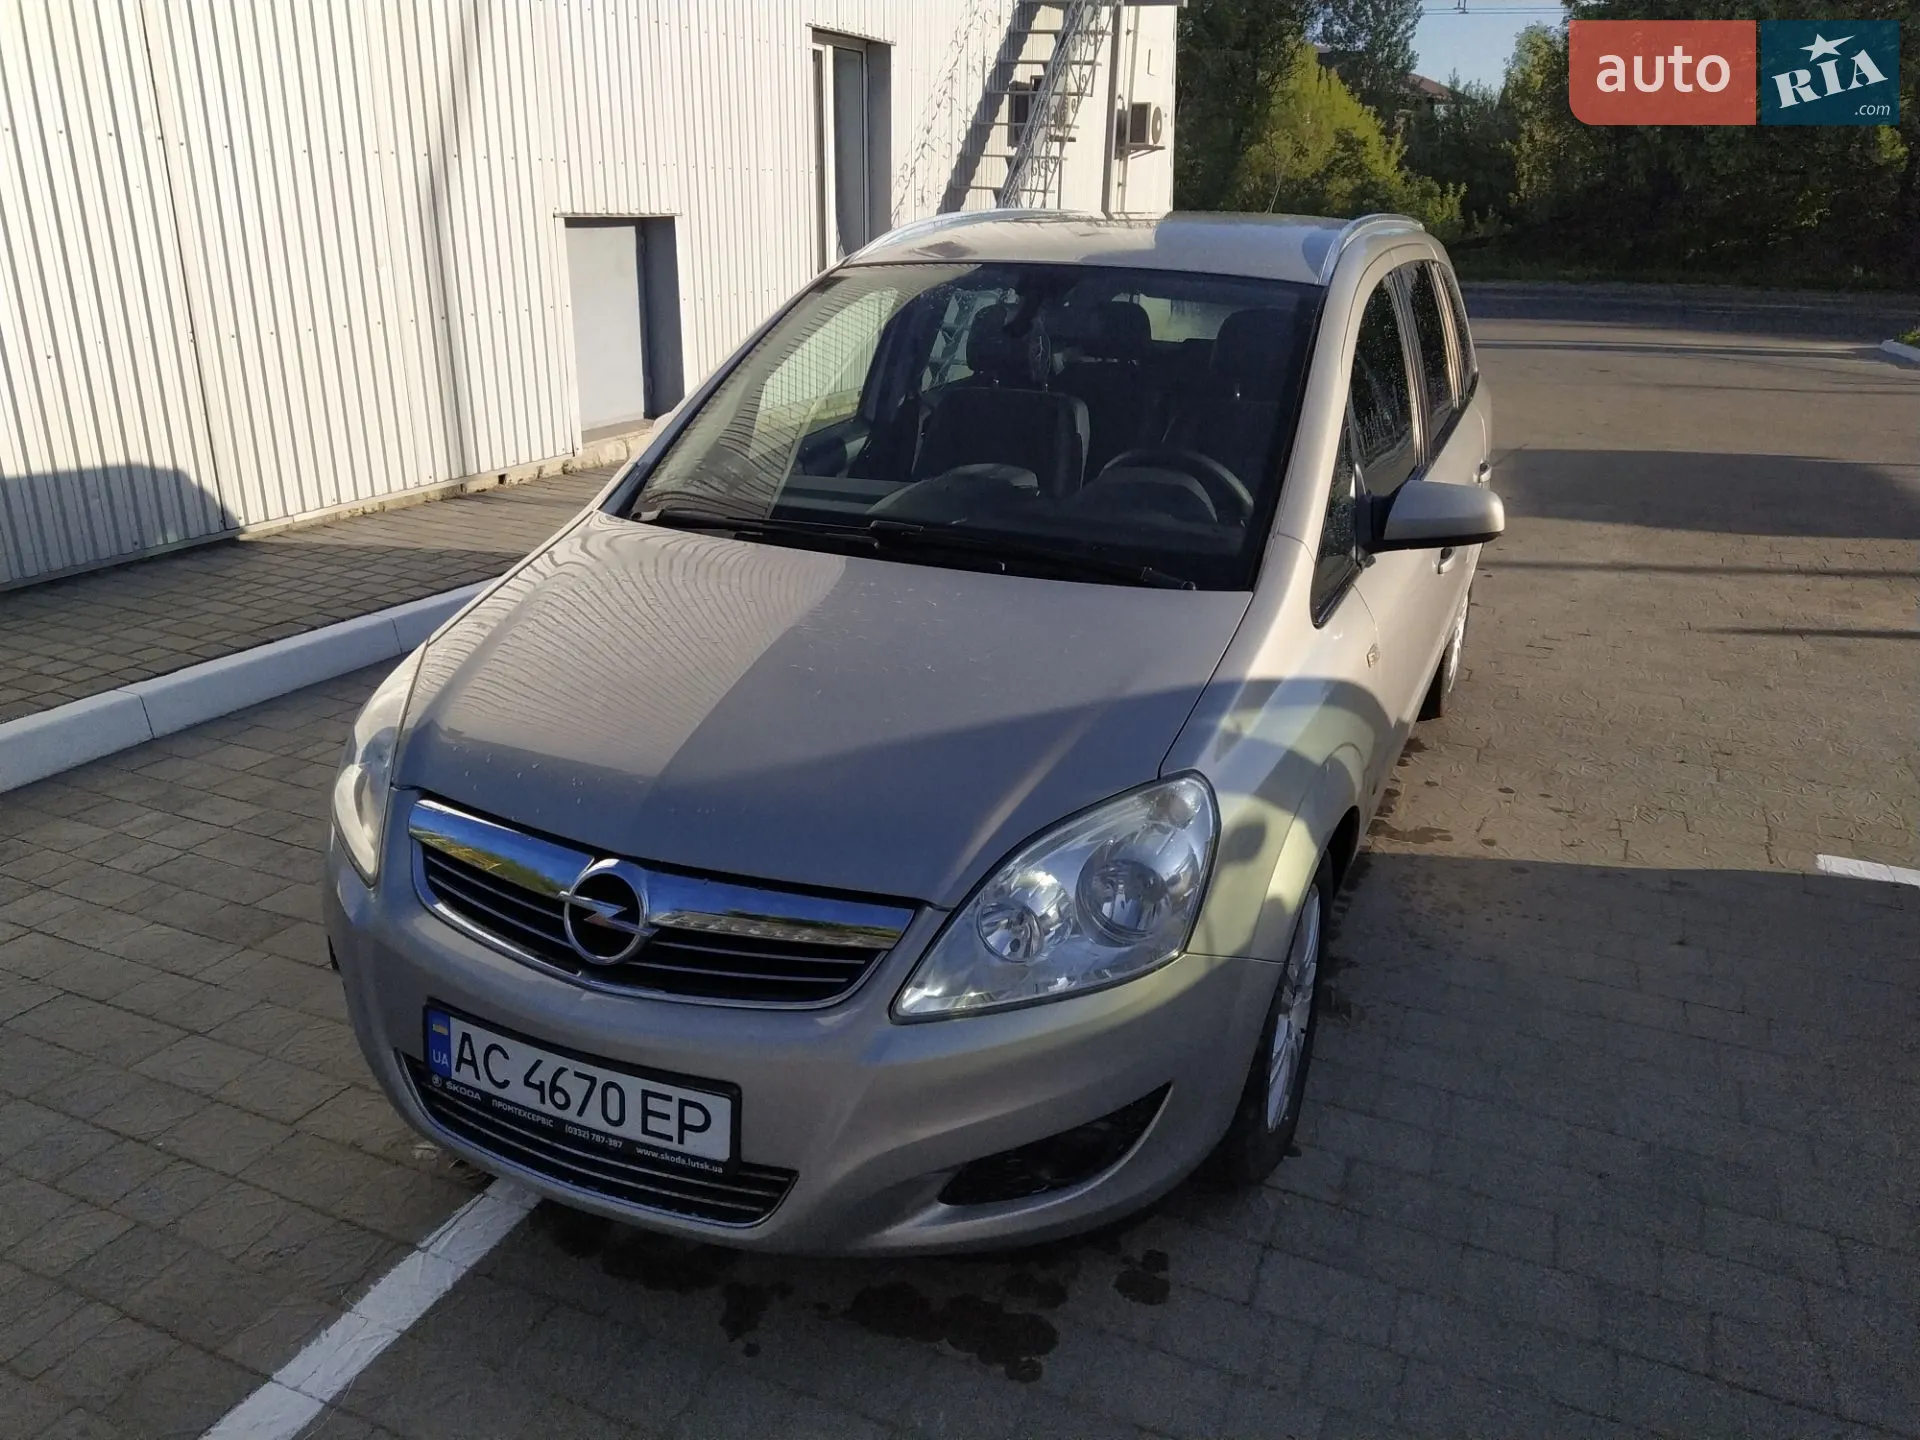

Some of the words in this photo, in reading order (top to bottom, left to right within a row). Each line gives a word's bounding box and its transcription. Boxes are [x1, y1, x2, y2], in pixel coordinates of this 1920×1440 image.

[432, 1049, 449, 1067] UA
[455, 1032, 510, 1089] AC
[523, 1059, 627, 1127] 4670
[641, 1089, 712, 1145] EP
[636, 1146, 724, 1174] www.skoda.lutsk.ua
